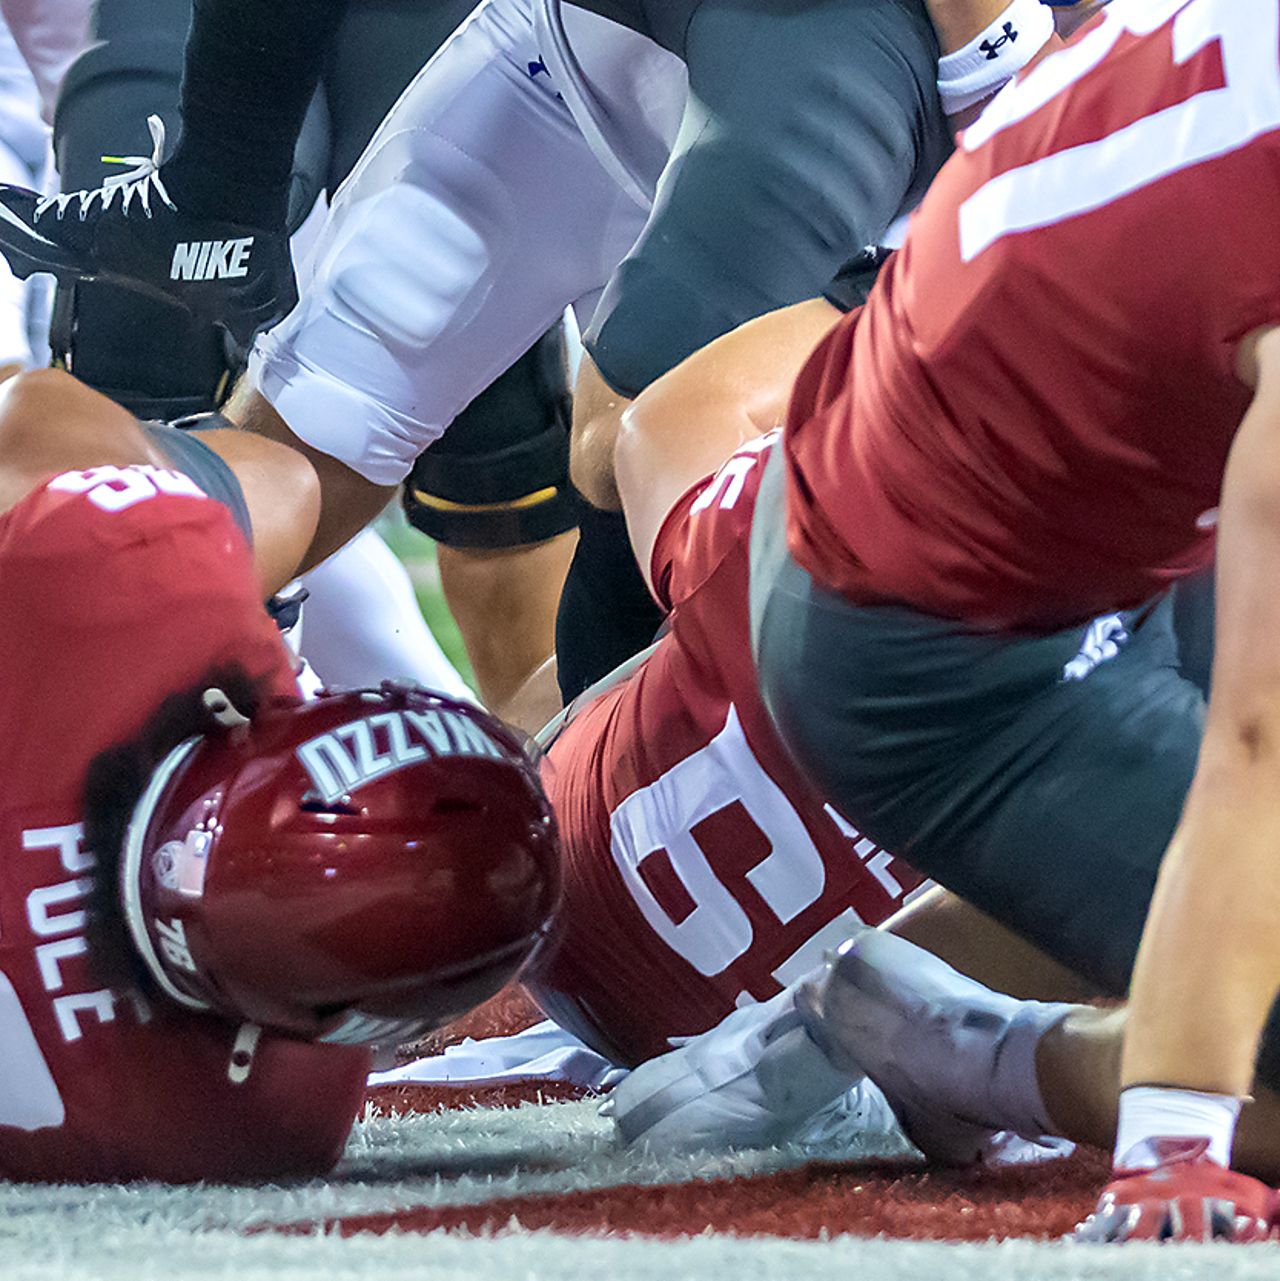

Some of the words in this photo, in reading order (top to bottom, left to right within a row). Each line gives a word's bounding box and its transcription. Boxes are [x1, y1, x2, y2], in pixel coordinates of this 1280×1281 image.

[170, 236, 255, 281] NIKE
[295, 708, 505, 805] WAZZU
[22, 822, 118, 1043] PULE
[610, 701, 866, 1046] 6
